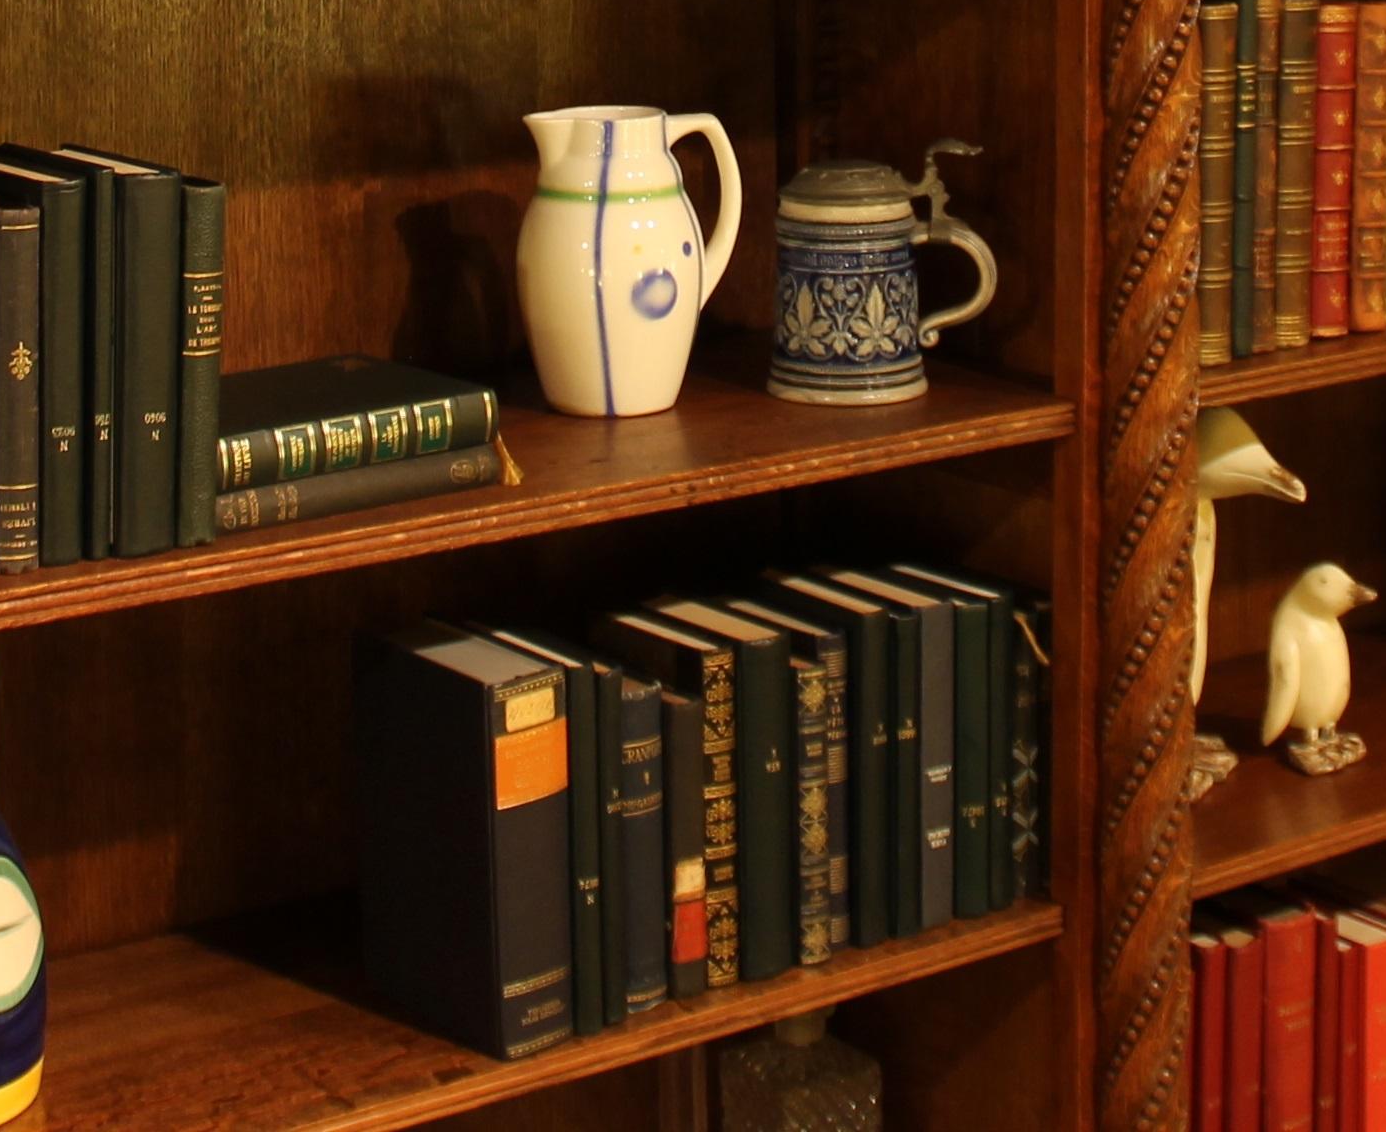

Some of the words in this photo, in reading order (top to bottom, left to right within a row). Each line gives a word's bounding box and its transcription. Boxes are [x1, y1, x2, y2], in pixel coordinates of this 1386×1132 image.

[99, 428, 109, 441] N
[152, 429, 160, 441] N
[59, 439, 69, 452] N
